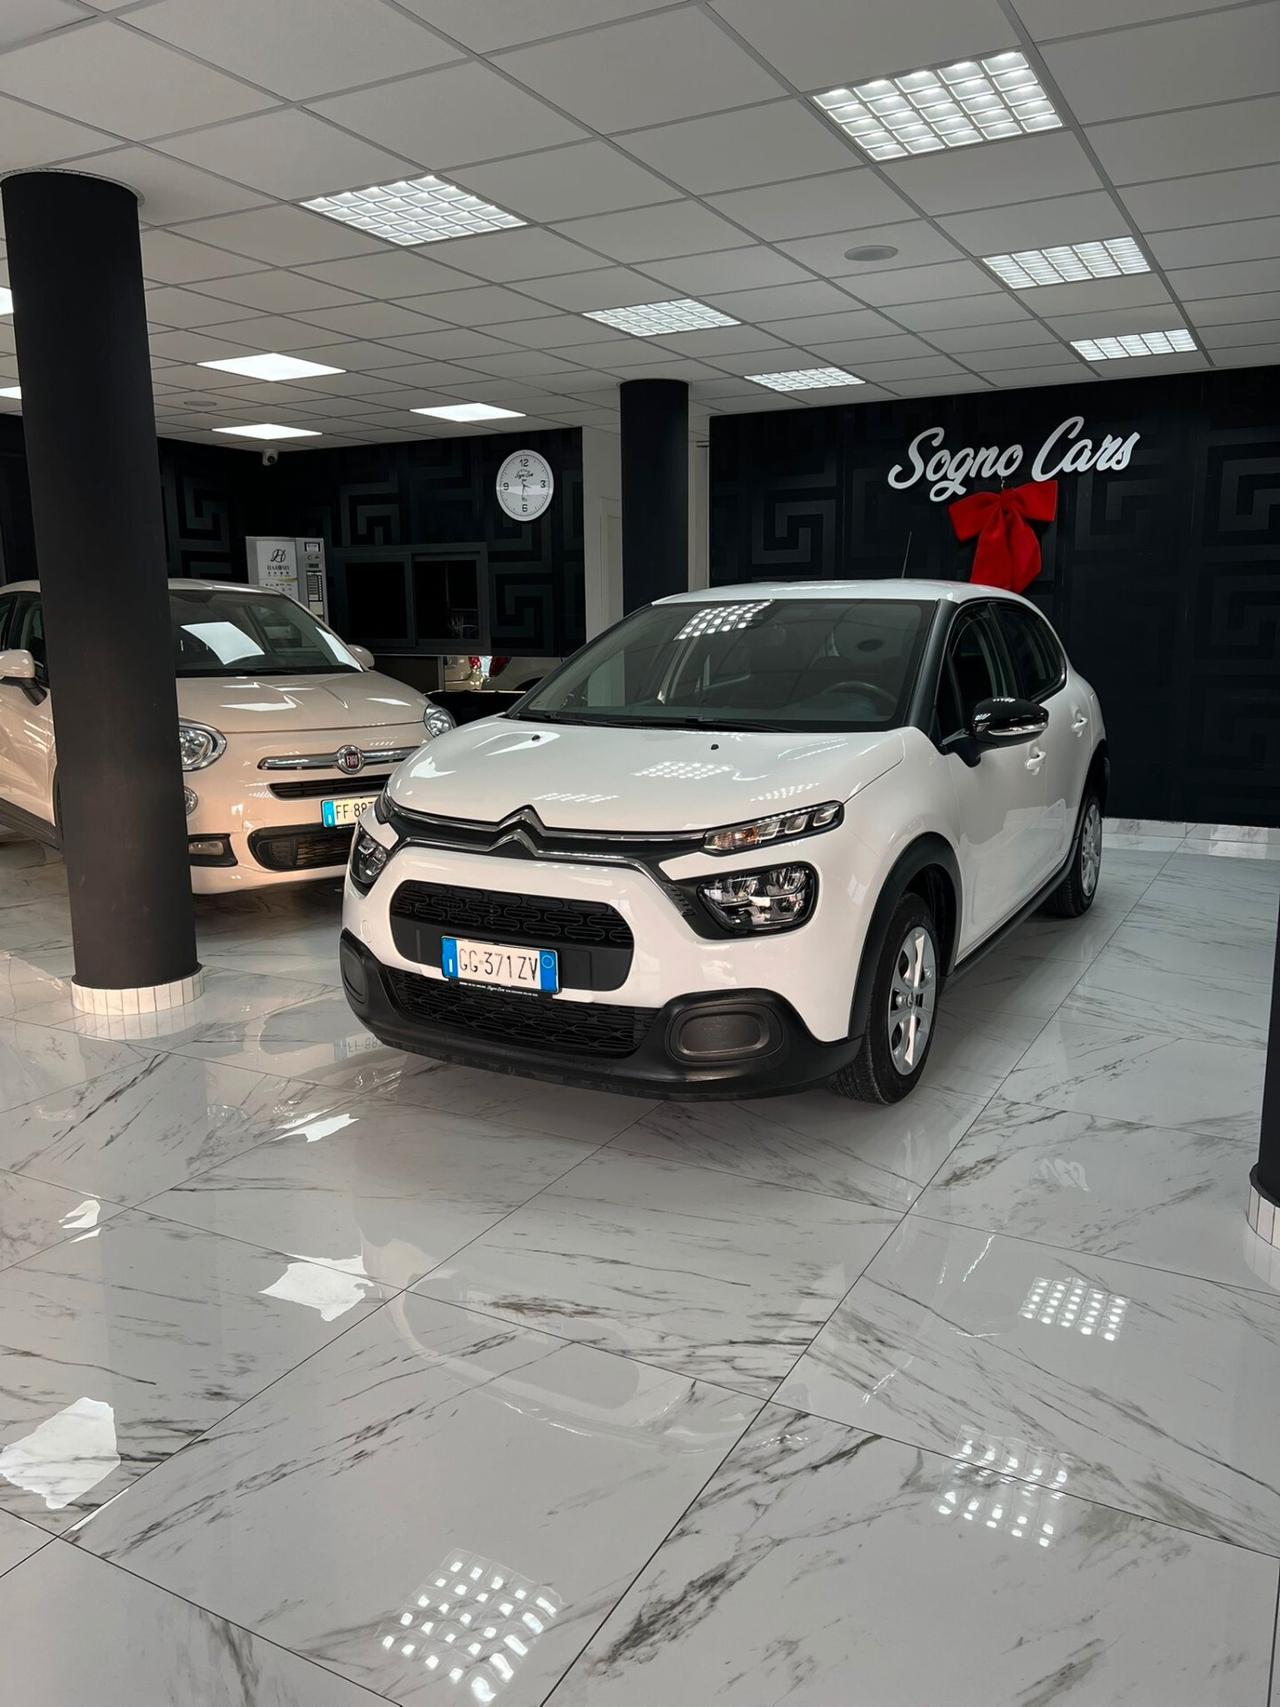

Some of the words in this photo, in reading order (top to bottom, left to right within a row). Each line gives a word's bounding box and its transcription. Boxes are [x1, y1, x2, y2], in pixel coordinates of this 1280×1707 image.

[520, 459, 529, 467] 12
[887, 426, 1024, 502] Sogno
[1031, 416, 1141, 482] Cars
[503, 482, 510, 490] 9
[540, 480, 546, 488] 3
[522, 504, 528, 512] 6
[354, 801, 373, 818] 88
